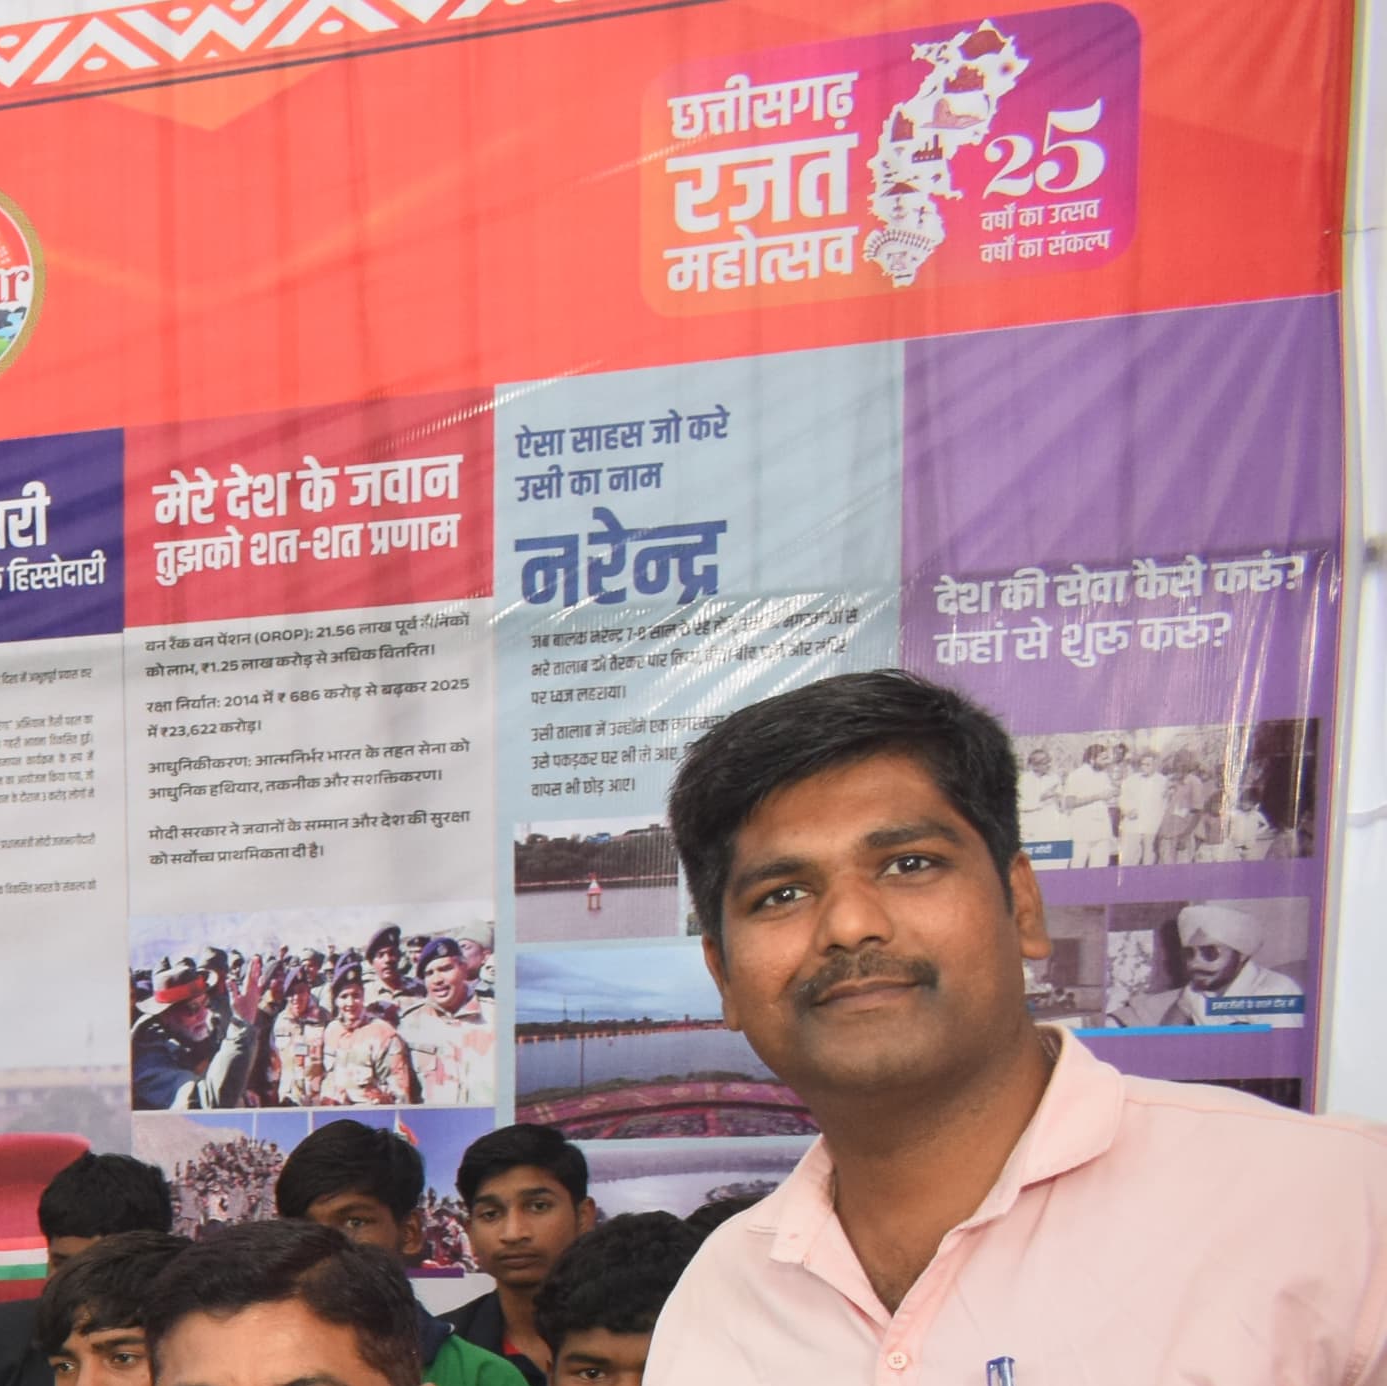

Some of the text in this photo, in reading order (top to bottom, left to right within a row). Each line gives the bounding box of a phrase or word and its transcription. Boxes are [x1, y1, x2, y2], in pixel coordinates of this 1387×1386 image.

[667, 72, 859, 140] छत्तीसगढ़
[665, 132, 859, 233] रजत
[982, 99, 1105, 200] 25
[979, 199, 1101, 231] वर्षों का उत्सव
[979, 229, 1112, 263] वर्षों का संकल्प
[663, 226, 859, 292] महोत्सव
[515, 404, 731, 459] ऐसा साहस जो करे
[152, 454, 463, 525] मेरे देश के जवान
[515, 462, 664, 502] उसी का नाम
[6, 549, 106, 592] हिस्सेदारी
[153, 513, 462, 586] तुझको शत-शत प्रणाम
[514, 506, 727, 609] नरेन्द्र
[149, 851, 169, 865] को
[215, 846, 290, 862] प्राथमिकता
[290, 843, 308, 858] दी
[307, 842, 324, 859] है।
